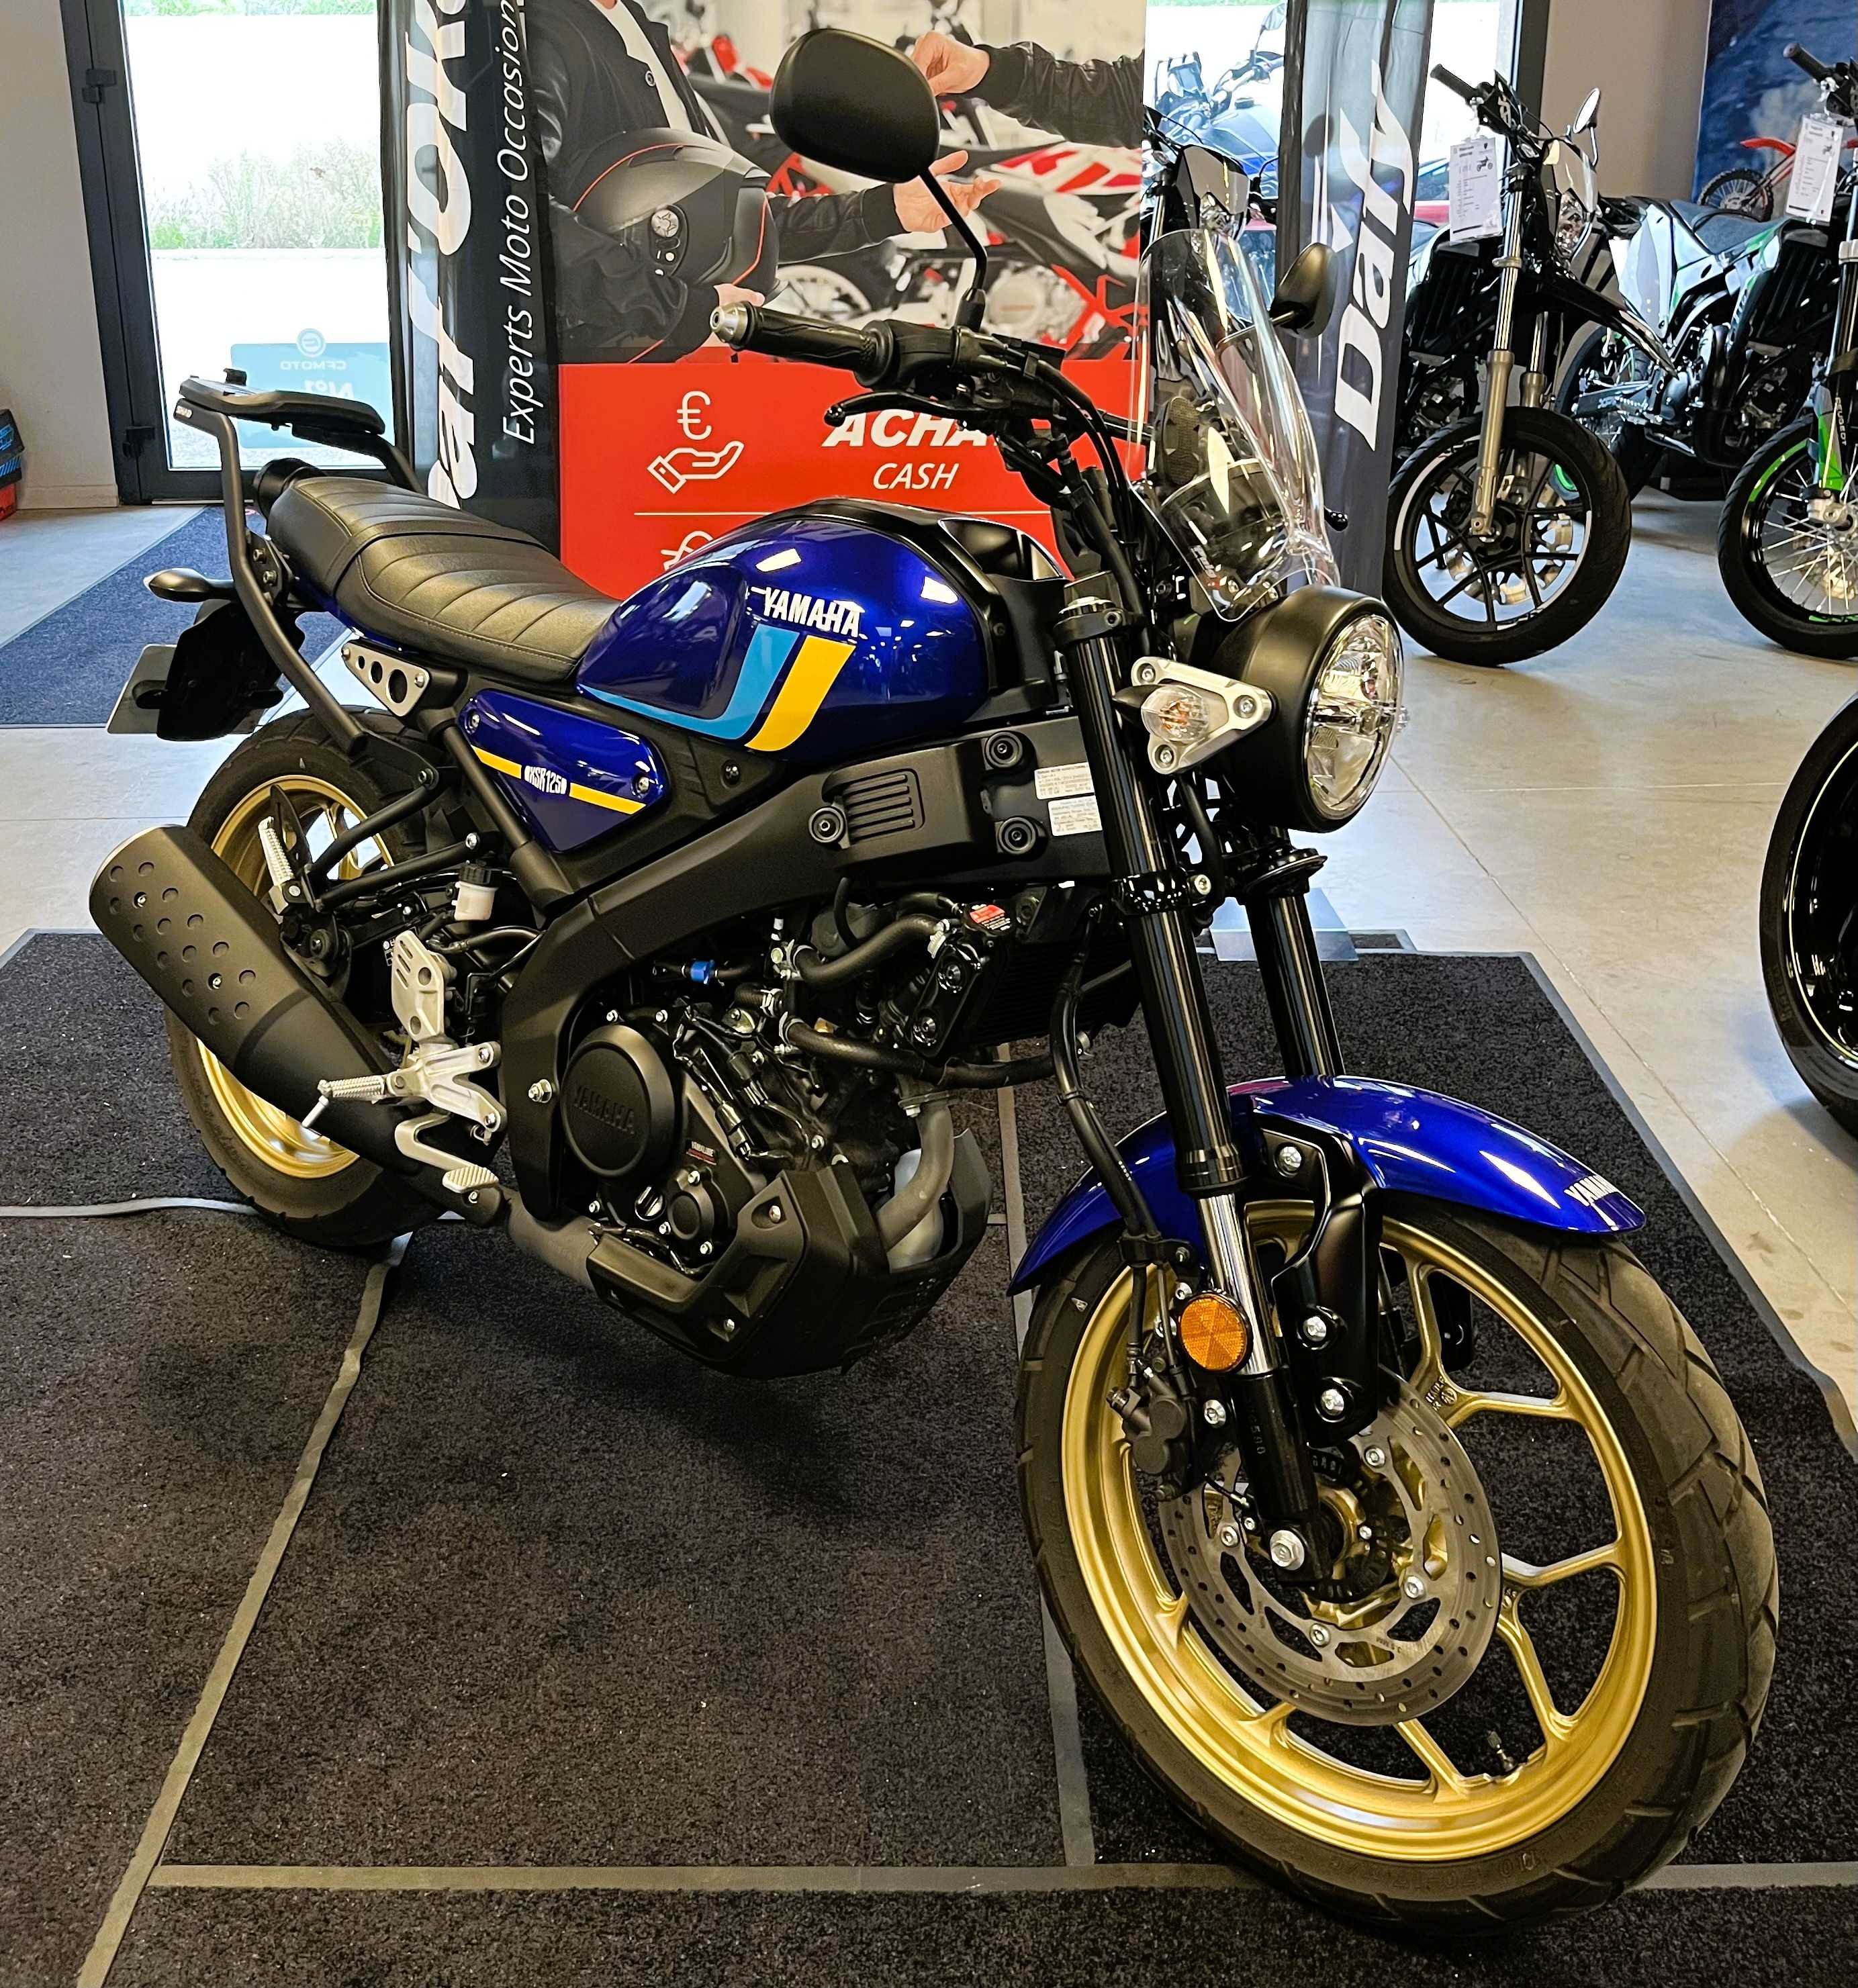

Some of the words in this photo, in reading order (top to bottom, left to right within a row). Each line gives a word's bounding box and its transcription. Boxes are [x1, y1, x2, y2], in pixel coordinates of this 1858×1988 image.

[499, 195, 532, 296] Moto
[1334, 59, 1413, 452] Dafy
[502, 305, 544, 444] Experts
[821, 409, 998, 448] ACHA
[873, 463, 960, 490] CASH
[763, 586, 861, 638] YAMAHA
[573, 1084, 635, 1135] YAMAHA
